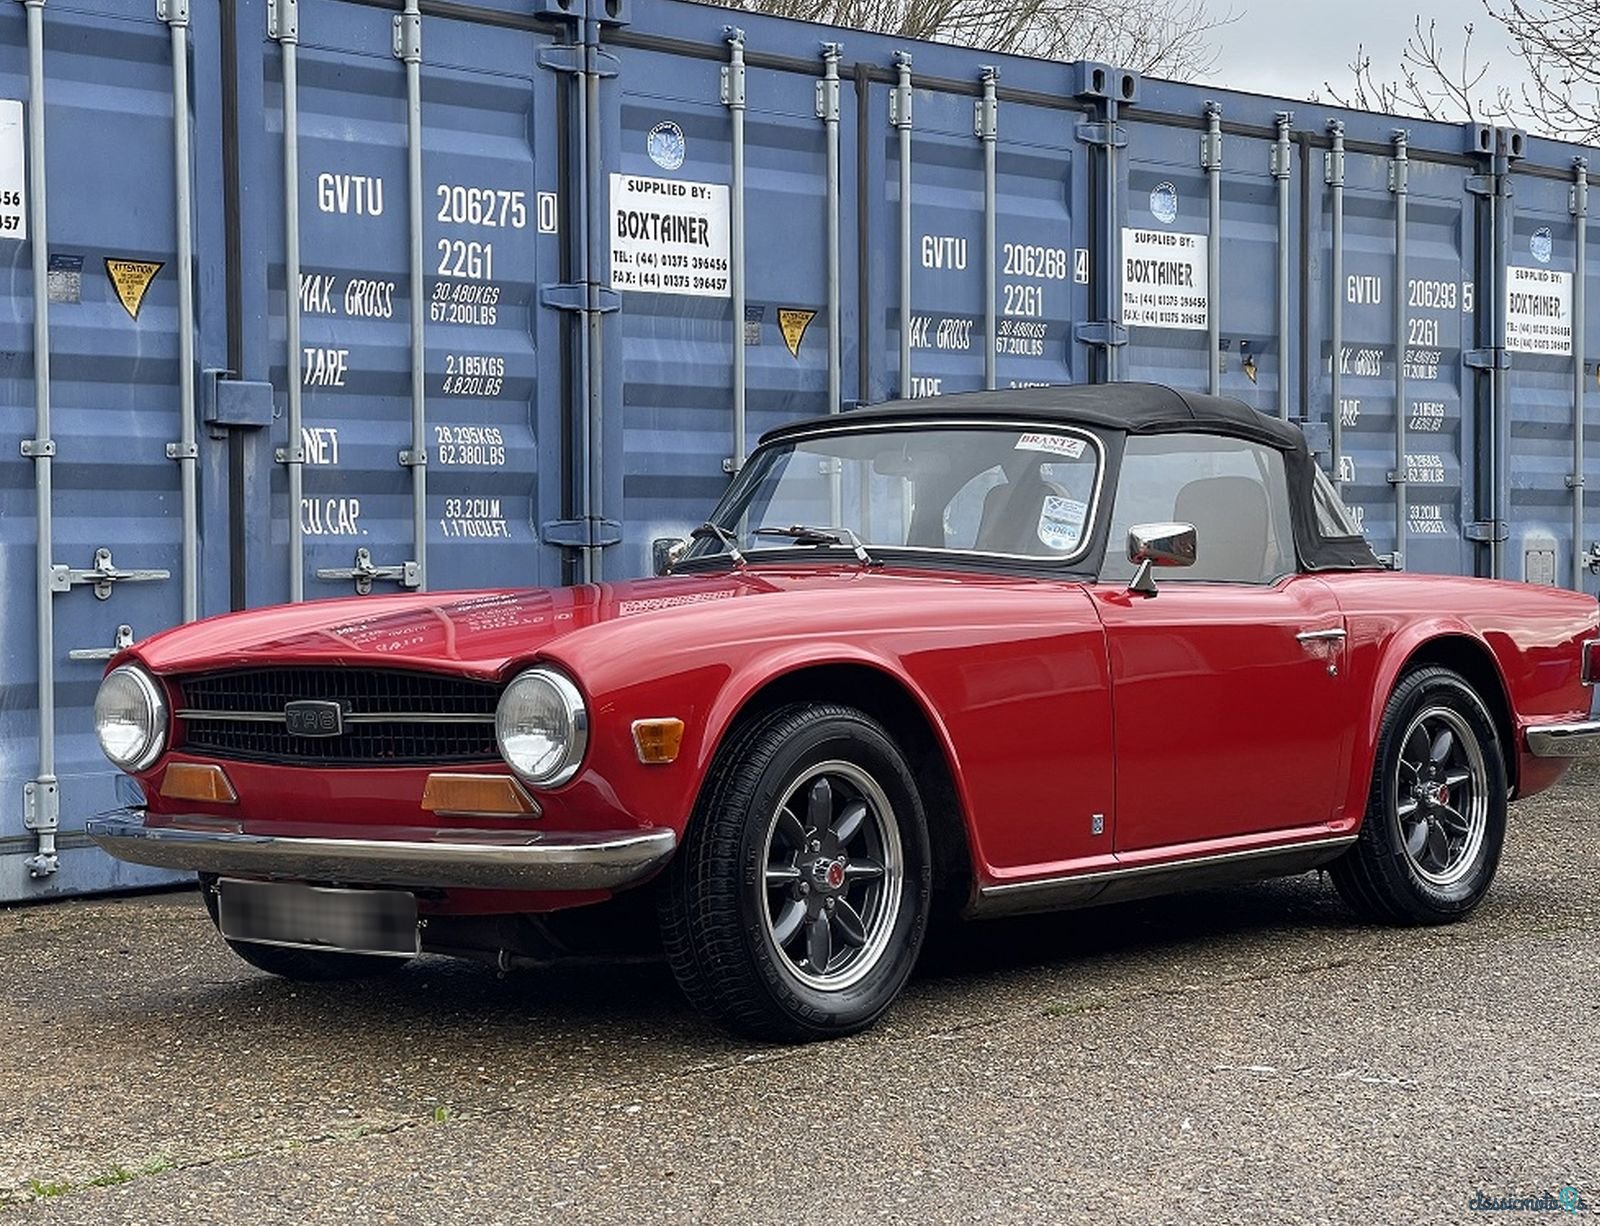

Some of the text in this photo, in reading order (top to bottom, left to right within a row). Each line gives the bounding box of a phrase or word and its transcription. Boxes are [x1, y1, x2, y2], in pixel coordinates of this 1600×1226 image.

[0, 191, 20, 206] 56
[318, 173, 556, 232] GVTU 206275 0
[628, 180, 711, 200] SUPPLIED BY:
[617, 210, 710, 247] BOXTAINER
[1135, 232, 1176, 246] SUPPLIED
[438, 239, 492, 280] 22G1
[613, 250, 727, 271] TEL: (44) 01375 396456
[922, 236, 1088, 283] GVTU 206268 4
[1127, 259, 1193, 287] BOXTAINER
[432, 283, 500, 304] 30.480KGS
[613, 270, 727, 290] FAX: (44) 01375 396457
[1348, 275, 1381, 304] GVTU
[1408, 280, 1456, 309] 206293
[345, 280, 394, 318] GROSS
[1004, 285, 1043, 317] 22G1
[430, 302, 496, 325] 67.200LBS
[937, 319, 972, 350] GROSS
[1408, 318, 1438, 346] 22G1
[303, 348, 349, 386] TARE
[446, 355, 504, 376] 2.185KGS
[442, 378, 502, 395] 4.820LBS
[303, 428, 338, 465] NET
[435, 426, 503, 444] 28.295KGS
[1021, 435, 1078, 449] BRANTZ
[439, 446, 505, 465] 62.380LBS
[300, 499, 368, 535] CU.CAP.
